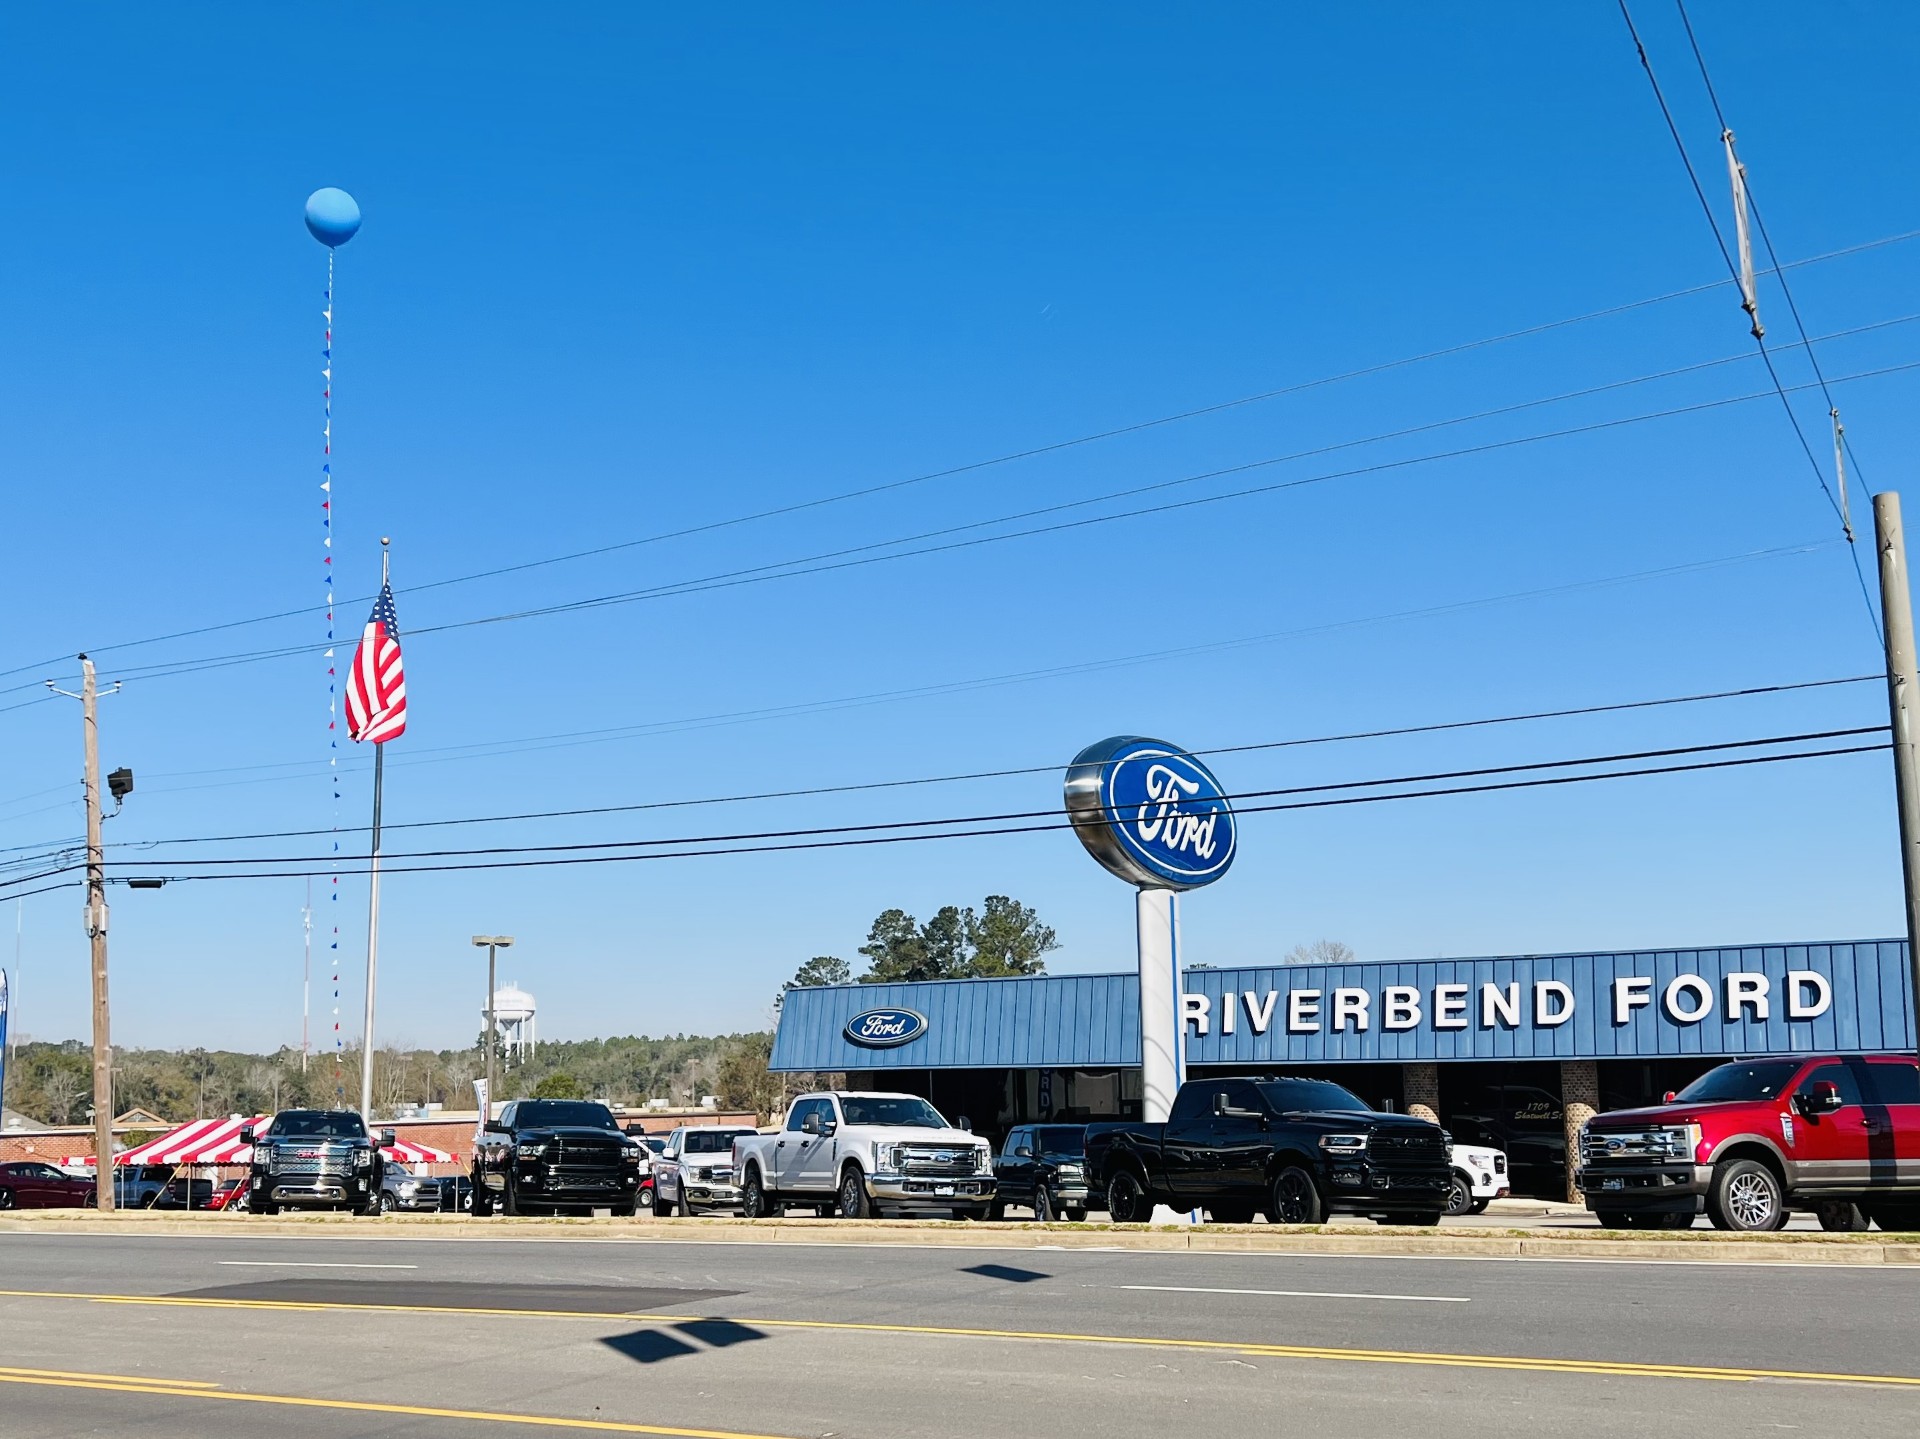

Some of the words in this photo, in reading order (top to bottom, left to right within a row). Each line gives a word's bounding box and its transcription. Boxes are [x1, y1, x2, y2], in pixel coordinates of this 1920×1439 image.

[1137, 764, 1217, 860] Ford
[1183, 980, 1575, 1034] RIVERBEND
[1615, 970, 1832, 1023] FORD
[861, 1014, 906, 1036] Ford
[1514, 1110, 1551, 1120] Shotwell
[1527, 1102, 1550, 1111] 1709
